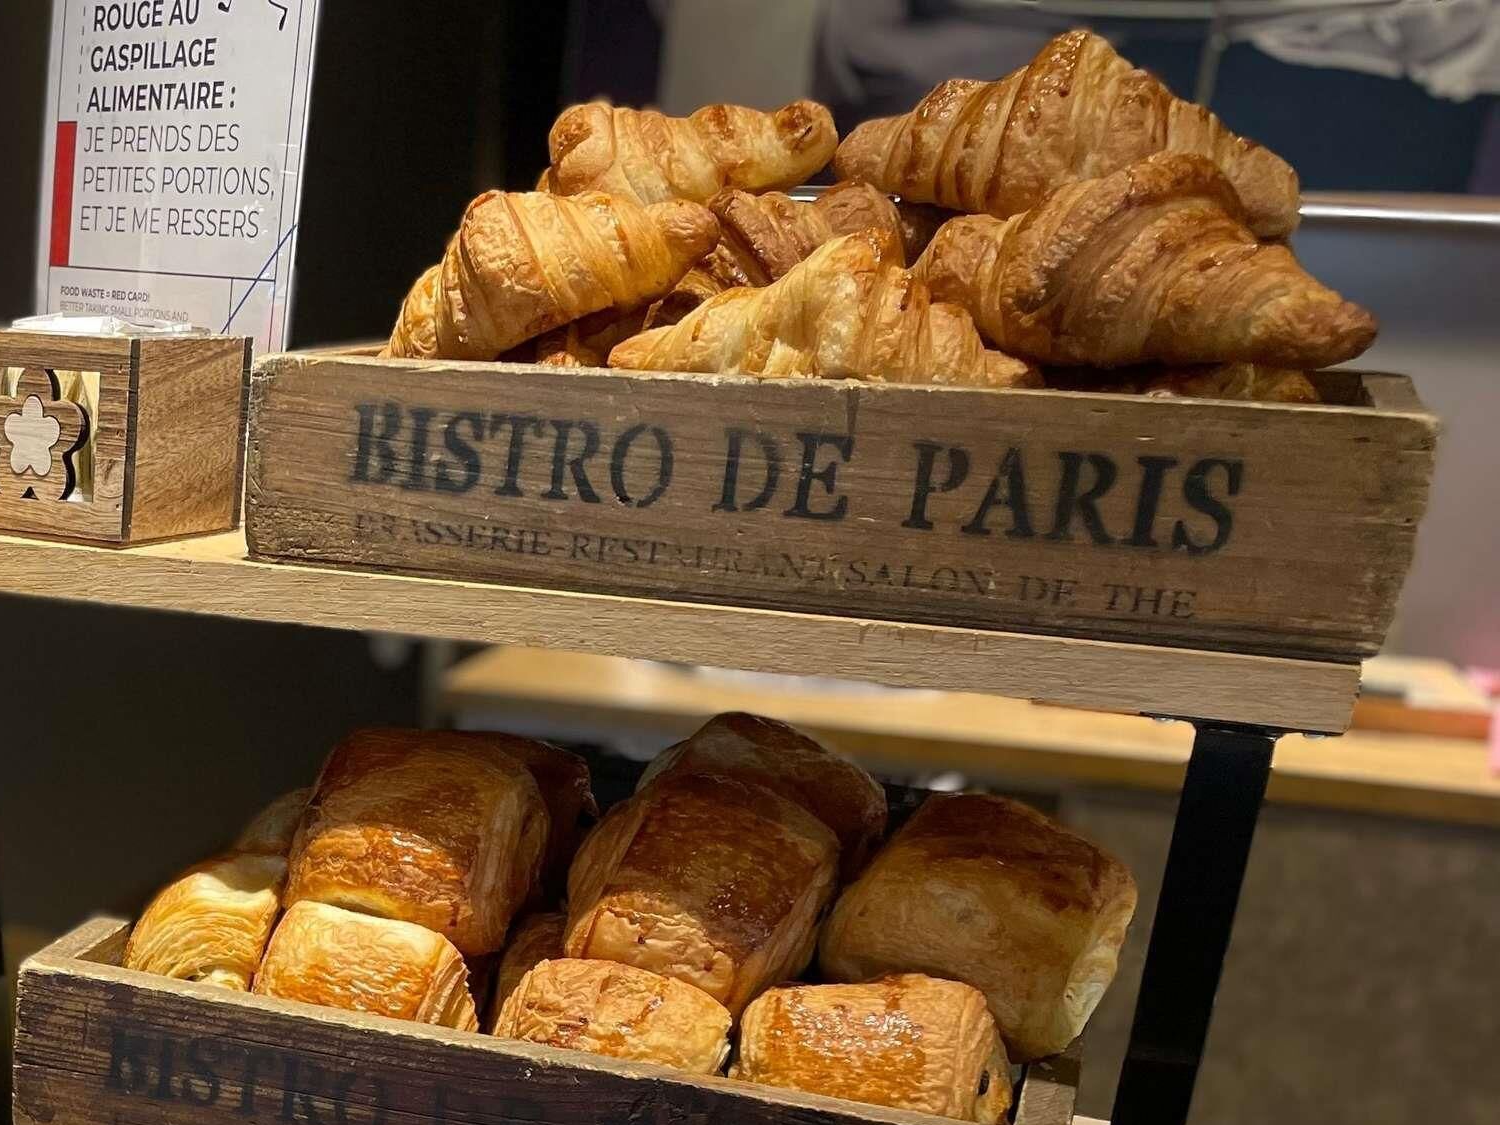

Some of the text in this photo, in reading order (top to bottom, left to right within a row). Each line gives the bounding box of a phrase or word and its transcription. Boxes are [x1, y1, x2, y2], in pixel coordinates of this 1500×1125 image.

[93, 0, 200, 32] ROUGE AU
[90, 38, 217, 73] GASPILLAGE
[86, 81, 225, 113] ALIMENTAIRE
[83, 123, 240, 153] JE PRENDS DES
[82, 166, 275, 201] PETITES PORTIONS,
[79, 205, 260, 239] ET JE ME RESSERS
[60, 286, 80, 297] FOOD
[80, 287, 106, 300] WASTE
[111, 290, 127, 301] RED
[60, 300, 189, 322] BETTER TAKING SMALL PORTIONS AND
[348, 402, 1246, 556] BISTRO DE PARIS
[1018, 575, 1079, 603] DE
[1102, 583, 1200, 620] THE
